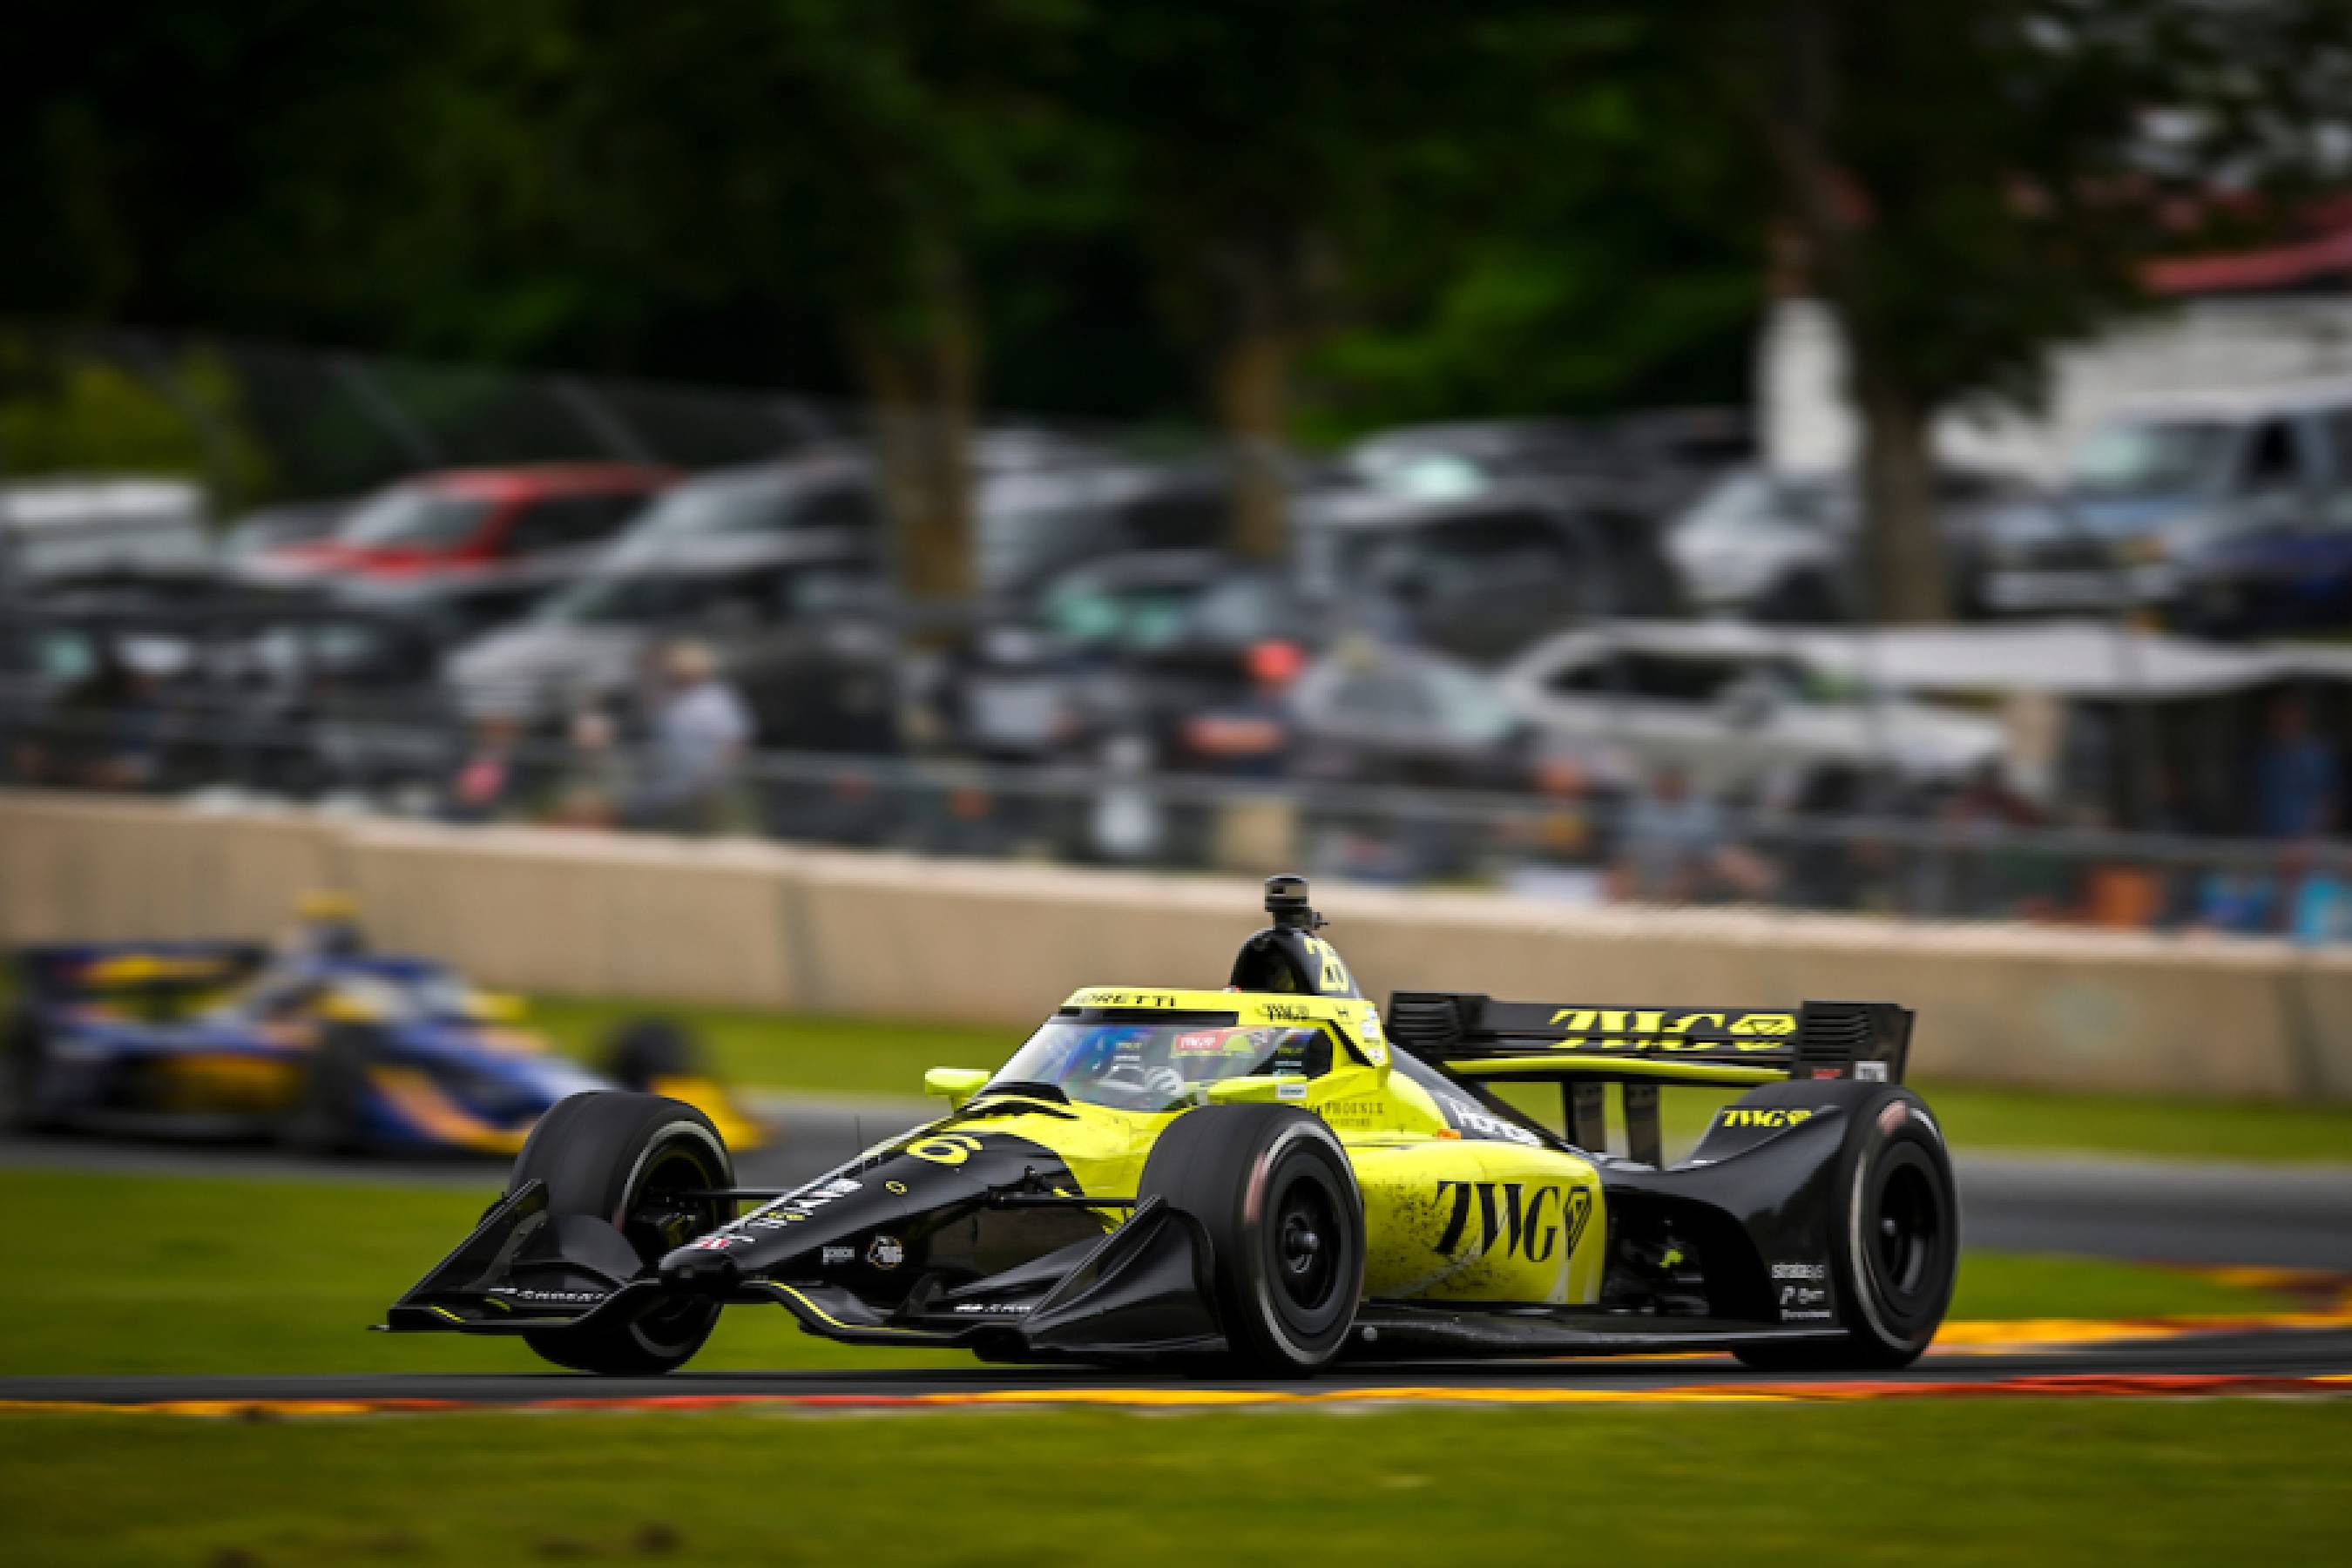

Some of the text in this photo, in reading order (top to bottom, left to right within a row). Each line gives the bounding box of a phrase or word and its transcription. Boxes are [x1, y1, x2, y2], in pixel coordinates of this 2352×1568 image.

[1547, 1008, 1726, 1051] TWG
[1721, 1109, 1781, 1128] TWG
[1433, 1180, 1561, 1263] TWG
